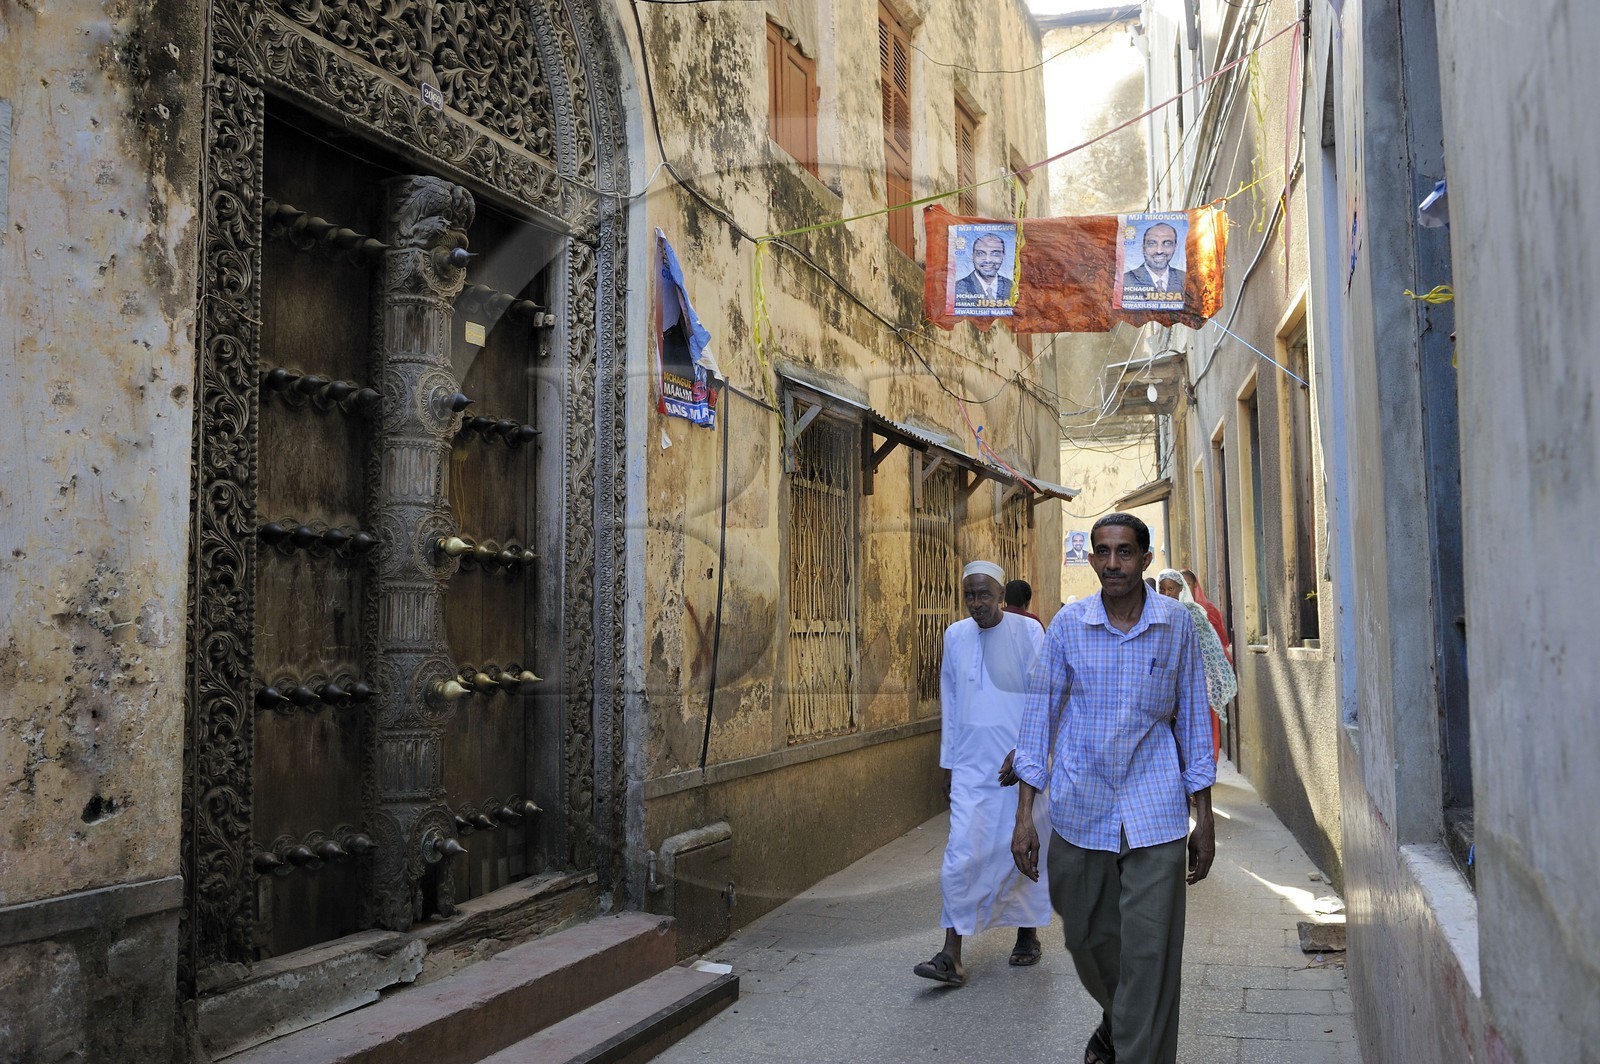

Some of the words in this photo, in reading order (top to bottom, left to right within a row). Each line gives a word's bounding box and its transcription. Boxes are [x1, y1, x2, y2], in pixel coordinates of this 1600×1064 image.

[976, 299, 1011, 307] JUSSA
[1145, 292, 1182, 300] JUSSA
[663, 371, 692, 389] MCHAGUE
[663, 382, 693, 402] MAALIM
[665, 402, 688, 418] RAIS
